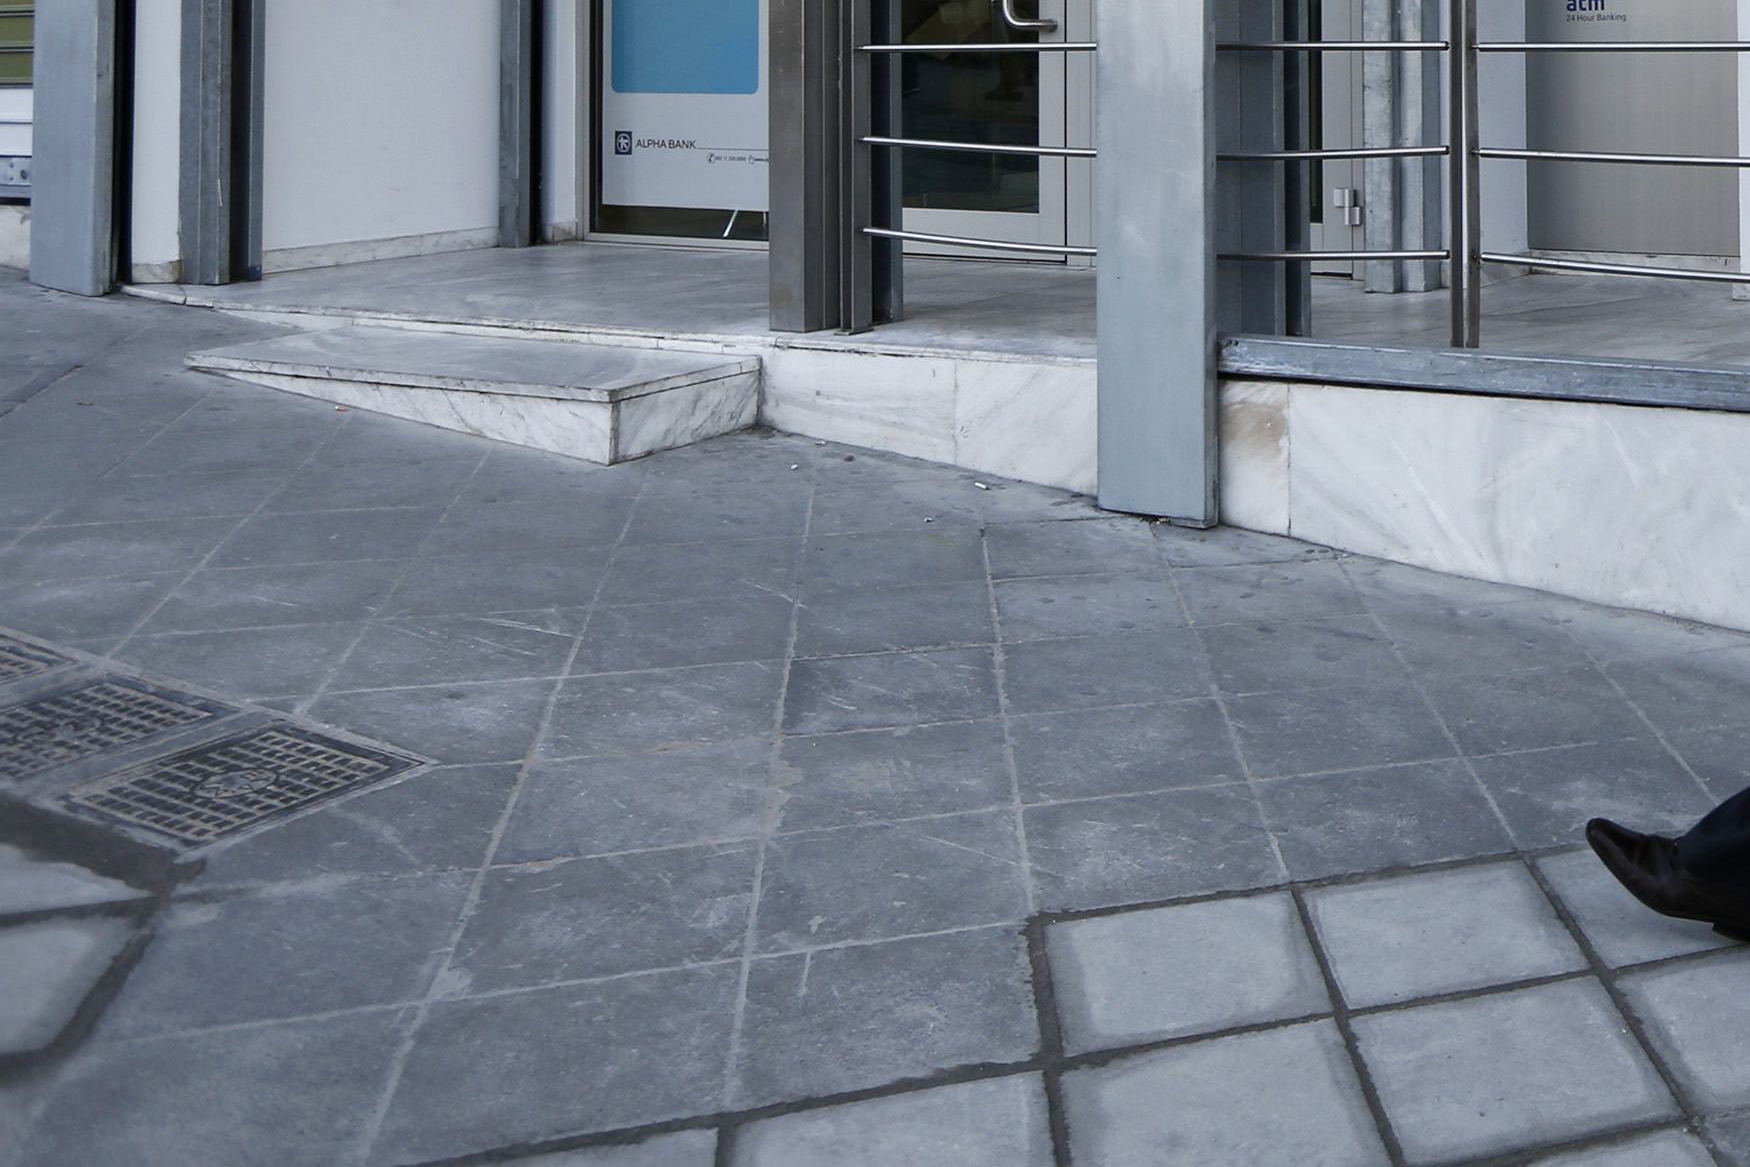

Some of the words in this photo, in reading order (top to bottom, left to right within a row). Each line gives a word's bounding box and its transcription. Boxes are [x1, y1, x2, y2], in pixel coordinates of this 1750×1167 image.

[1566, 14, 1576, 22] 24
[1577, 14, 1595, 22] Hour
[1596, 13, 1627, 22] Banking
[636, 138, 667, 149] ALPHA
[668, 139, 697, 149] BANK
